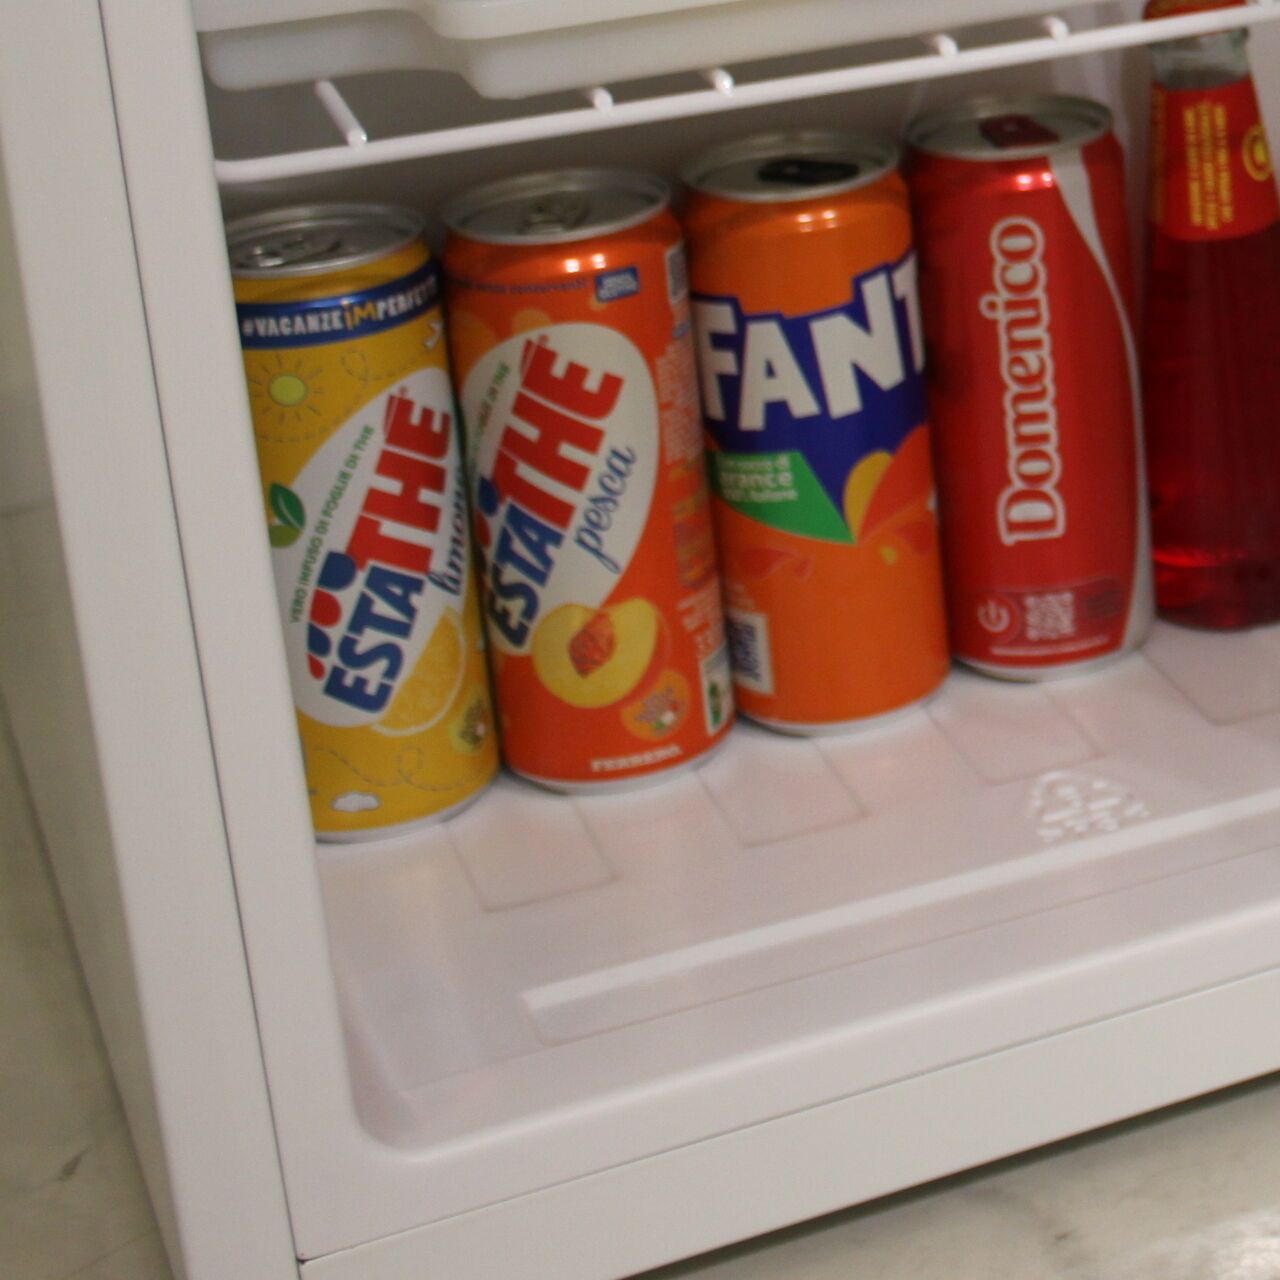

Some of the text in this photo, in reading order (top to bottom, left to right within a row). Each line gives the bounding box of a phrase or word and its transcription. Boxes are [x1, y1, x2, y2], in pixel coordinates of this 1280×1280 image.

[690, 250, 926, 432] FANT
[978, 216, 1067, 547] Domenico
[298, 536, 323, 585] INFUSO
[321, 470, 353, 519] FOGLIE
[573, 445, 637, 575] pesca
